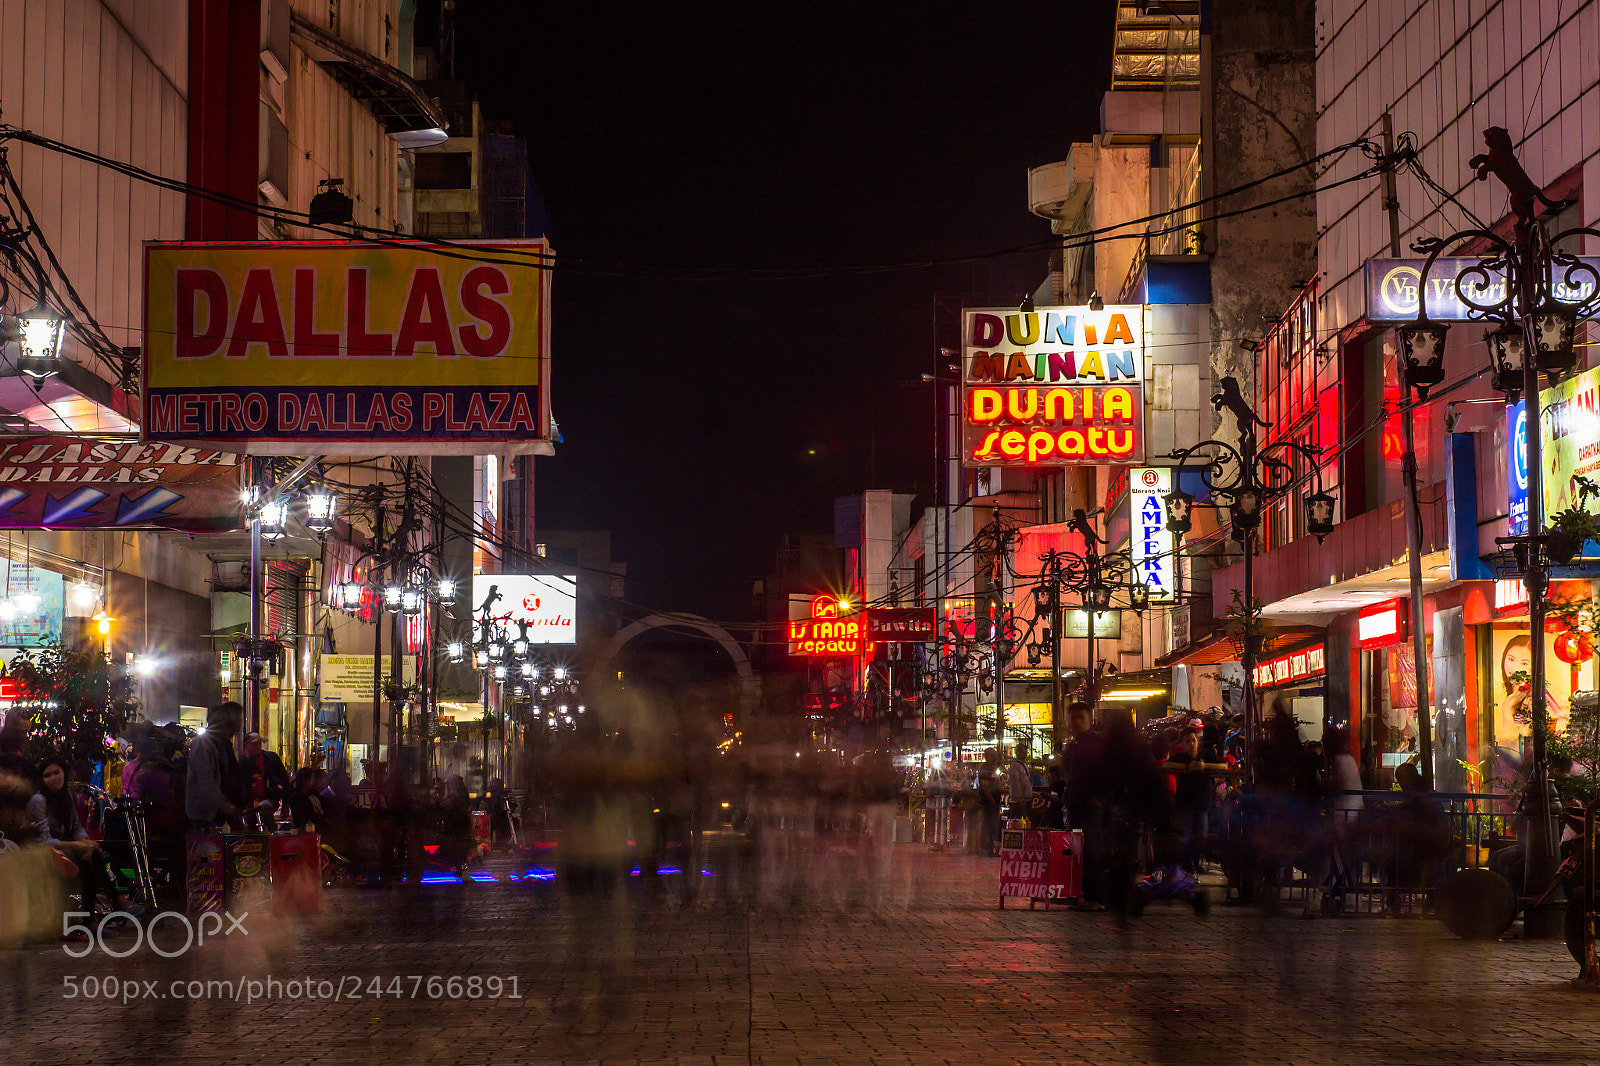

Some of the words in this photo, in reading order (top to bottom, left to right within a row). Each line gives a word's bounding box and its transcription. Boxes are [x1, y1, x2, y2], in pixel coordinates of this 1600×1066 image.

[1431, 277, 1508, 303] Victori
[173, 263, 513, 361] DALLAS
[968, 350, 1135, 382] MAINAN
[150, 392, 269, 433] METRO
[276, 392, 414, 432] DALLAS
[423, 392, 535, 431] PLAZA
[973, 426, 1134, 461] sepatu
[0, 466, 165, 483] DALLAS
[870, 619, 932, 632] Juwita
[1001, 860, 1048, 879] KIBIF
[1000, 882, 1065, 899] ATWURST
